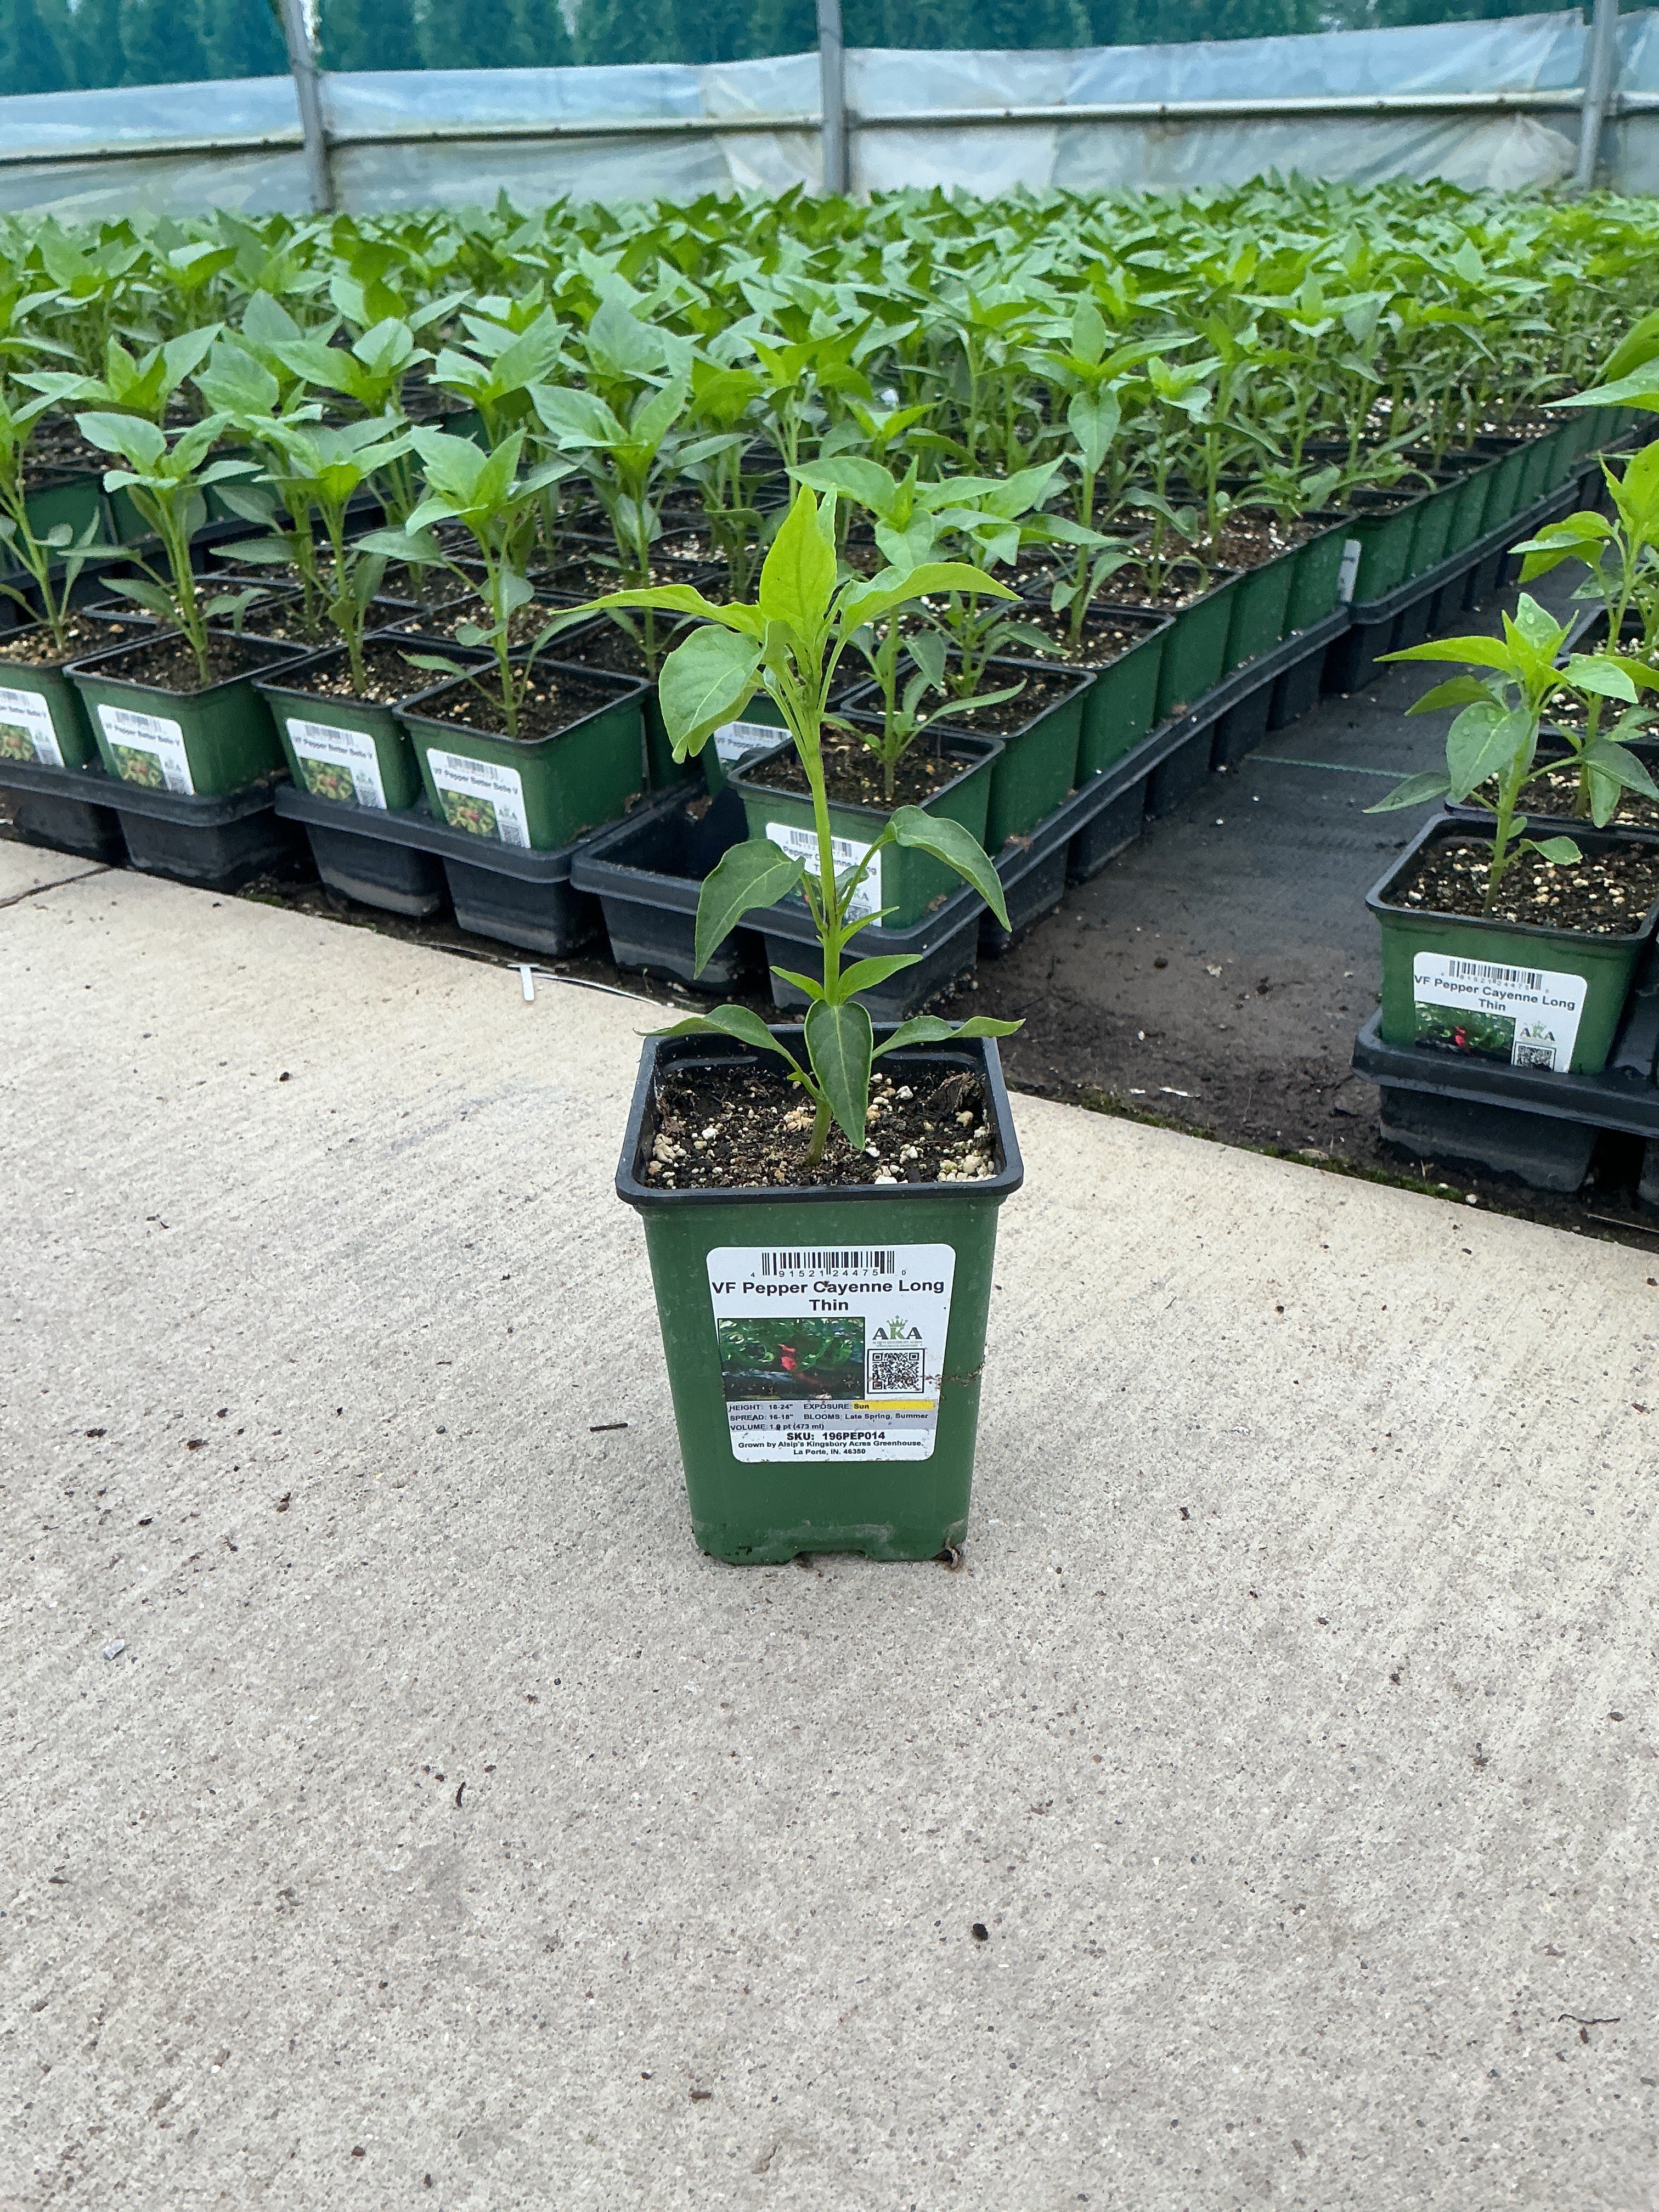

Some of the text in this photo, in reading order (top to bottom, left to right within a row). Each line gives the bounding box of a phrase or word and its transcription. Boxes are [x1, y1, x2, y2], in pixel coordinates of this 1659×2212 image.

[1414, 975, 1576, 1011] VF Pepper Cayenne Long
[1479, 998, 1506, 1012] Thin
[712, 1279, 945, 1296] VF Pepper Cayenne Long
[809, 1299, 849, 1311] Thin
[872, 1326, 923, 1340] AKA
[793, 1423, 810, 1431] (473
[787, 1431, 886, 1441] SKU: 196PEP014
